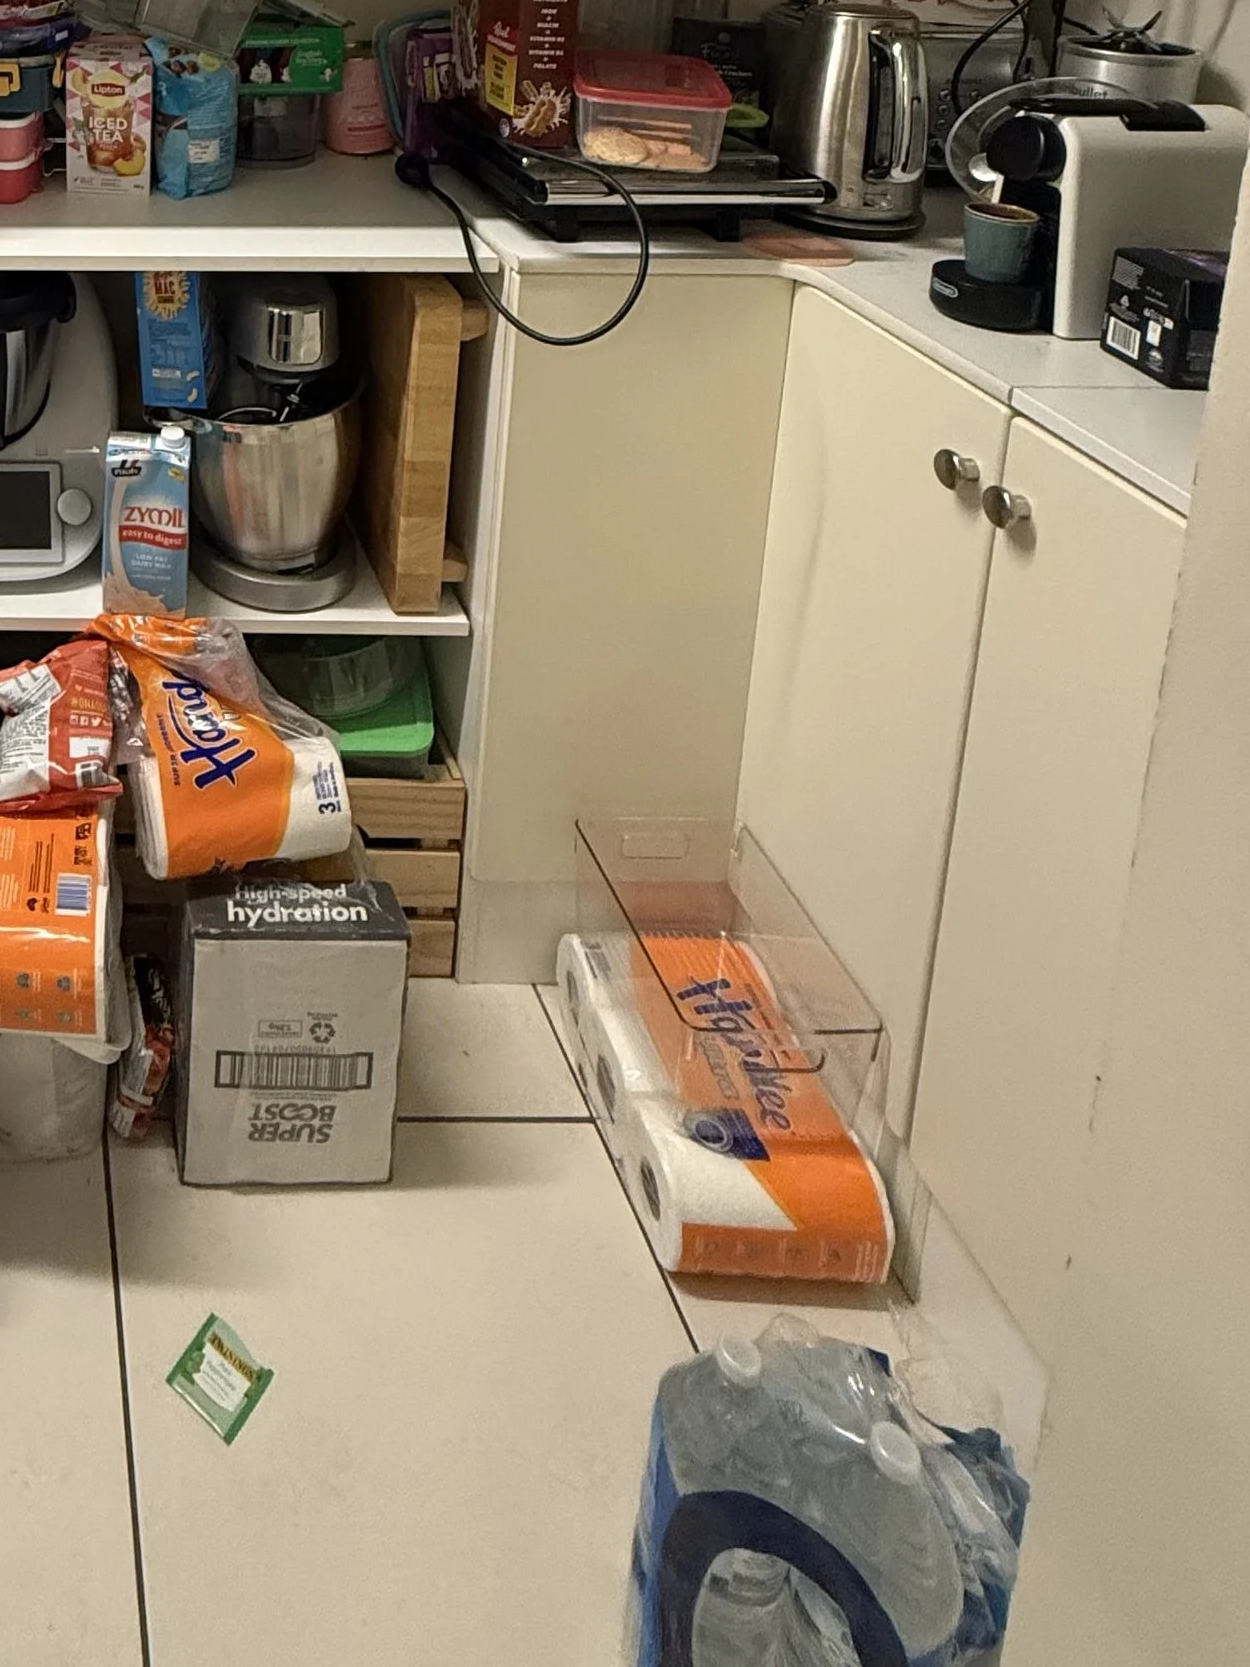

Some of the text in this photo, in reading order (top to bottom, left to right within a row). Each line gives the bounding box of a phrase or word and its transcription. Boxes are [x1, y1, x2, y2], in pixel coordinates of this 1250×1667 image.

[93, 85, 123, 96] Lipton
[88, 117, 128, 130] ICED
[92, 129, 124, 143] TEA
[121, 529, 182, 546] easy to digest
[130, 560, 152, 569] DAIRY
[135, 554, 167, 562] LOW FAT
[319, 802, 336, 815] 3
[235, 883, 348, 905] High-speed
[226, 900, 369, 928] hydration
[248, 1102, 338, 1122] BOOST
[248, 1121, 334, 1144] SUPER
